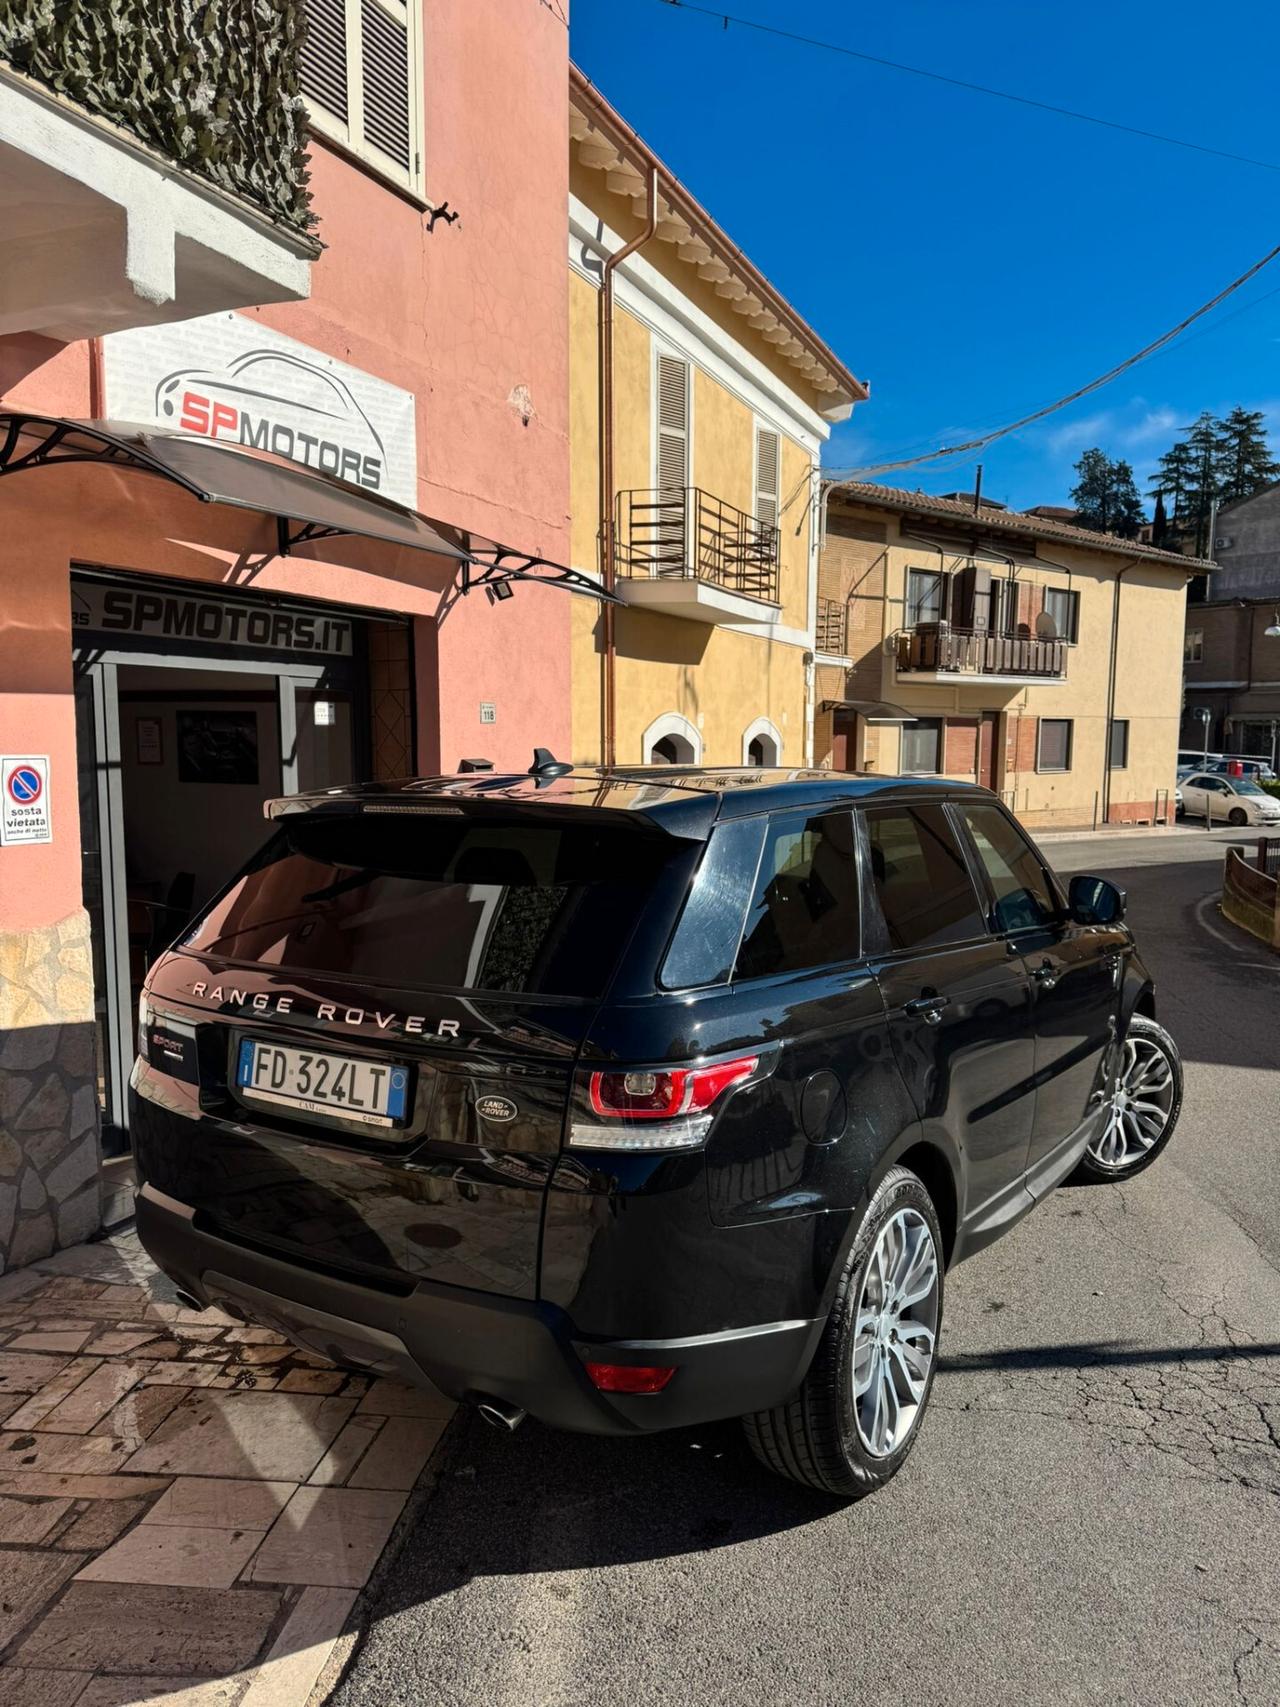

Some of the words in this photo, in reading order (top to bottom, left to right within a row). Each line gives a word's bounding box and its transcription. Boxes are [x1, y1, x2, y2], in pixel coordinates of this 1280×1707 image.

[180, 391, 382, 490] SPMOTORS
[102, 591, 349, 652] SPMOTORS.IT
[6, 818, 46, 827] vietata
[11, 807, 41, 816] sosta
[192, 981, 293, 1013] RANGE
[316, 1003, 461, 1038] ROVER
[254, 1047, 287, 1089] FD
[296, 1054, 386, 1109] 324LT
[483, 1100, 504, 1109] LAND
[484, 1107, 510, 1117] ROVER
